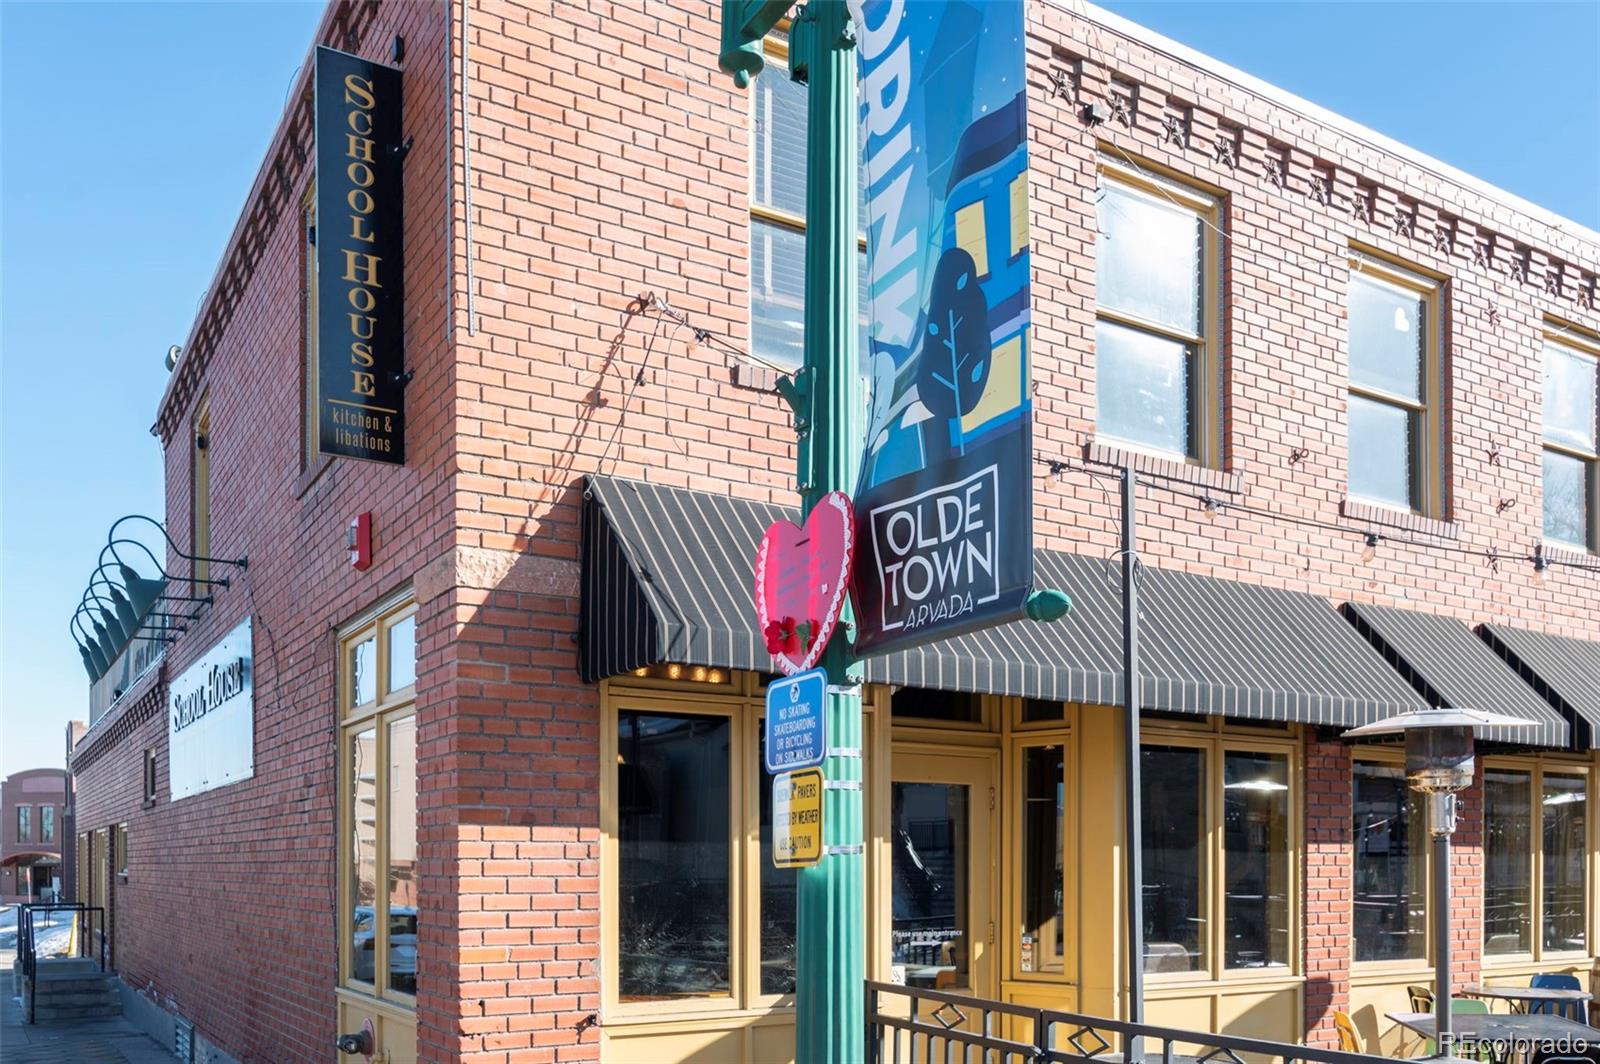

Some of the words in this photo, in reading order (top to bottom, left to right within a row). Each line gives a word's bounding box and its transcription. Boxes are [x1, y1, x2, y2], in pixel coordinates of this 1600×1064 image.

[345, 74, 376, 243] SCHOOL
[847, 0, 918, 348] DRINK
[341, 248, 382, 397] HOUSE
[332, 407, 379, 431] kitchen
[384, 415, 393, 433] &
[335, 428, 391, 452] libations
[886, 482, 983, 556] OLDE
[885, 531, 992, 606] TOWN
[903, 591, 973, 632] ARVADA
[778, 707, 787, 720] NO
[788, 702, 810, 718] SKATING
[774, 716, 816, 736] SKATEBOARDING
[776, 738, 784, 750] OR
[785, 732, 813, 747] BICYCLING
[775, 754, 783, 765] ON
[797, 783, 816, 799] PAVERS
[798, 809, 819, 824] WEATHER
